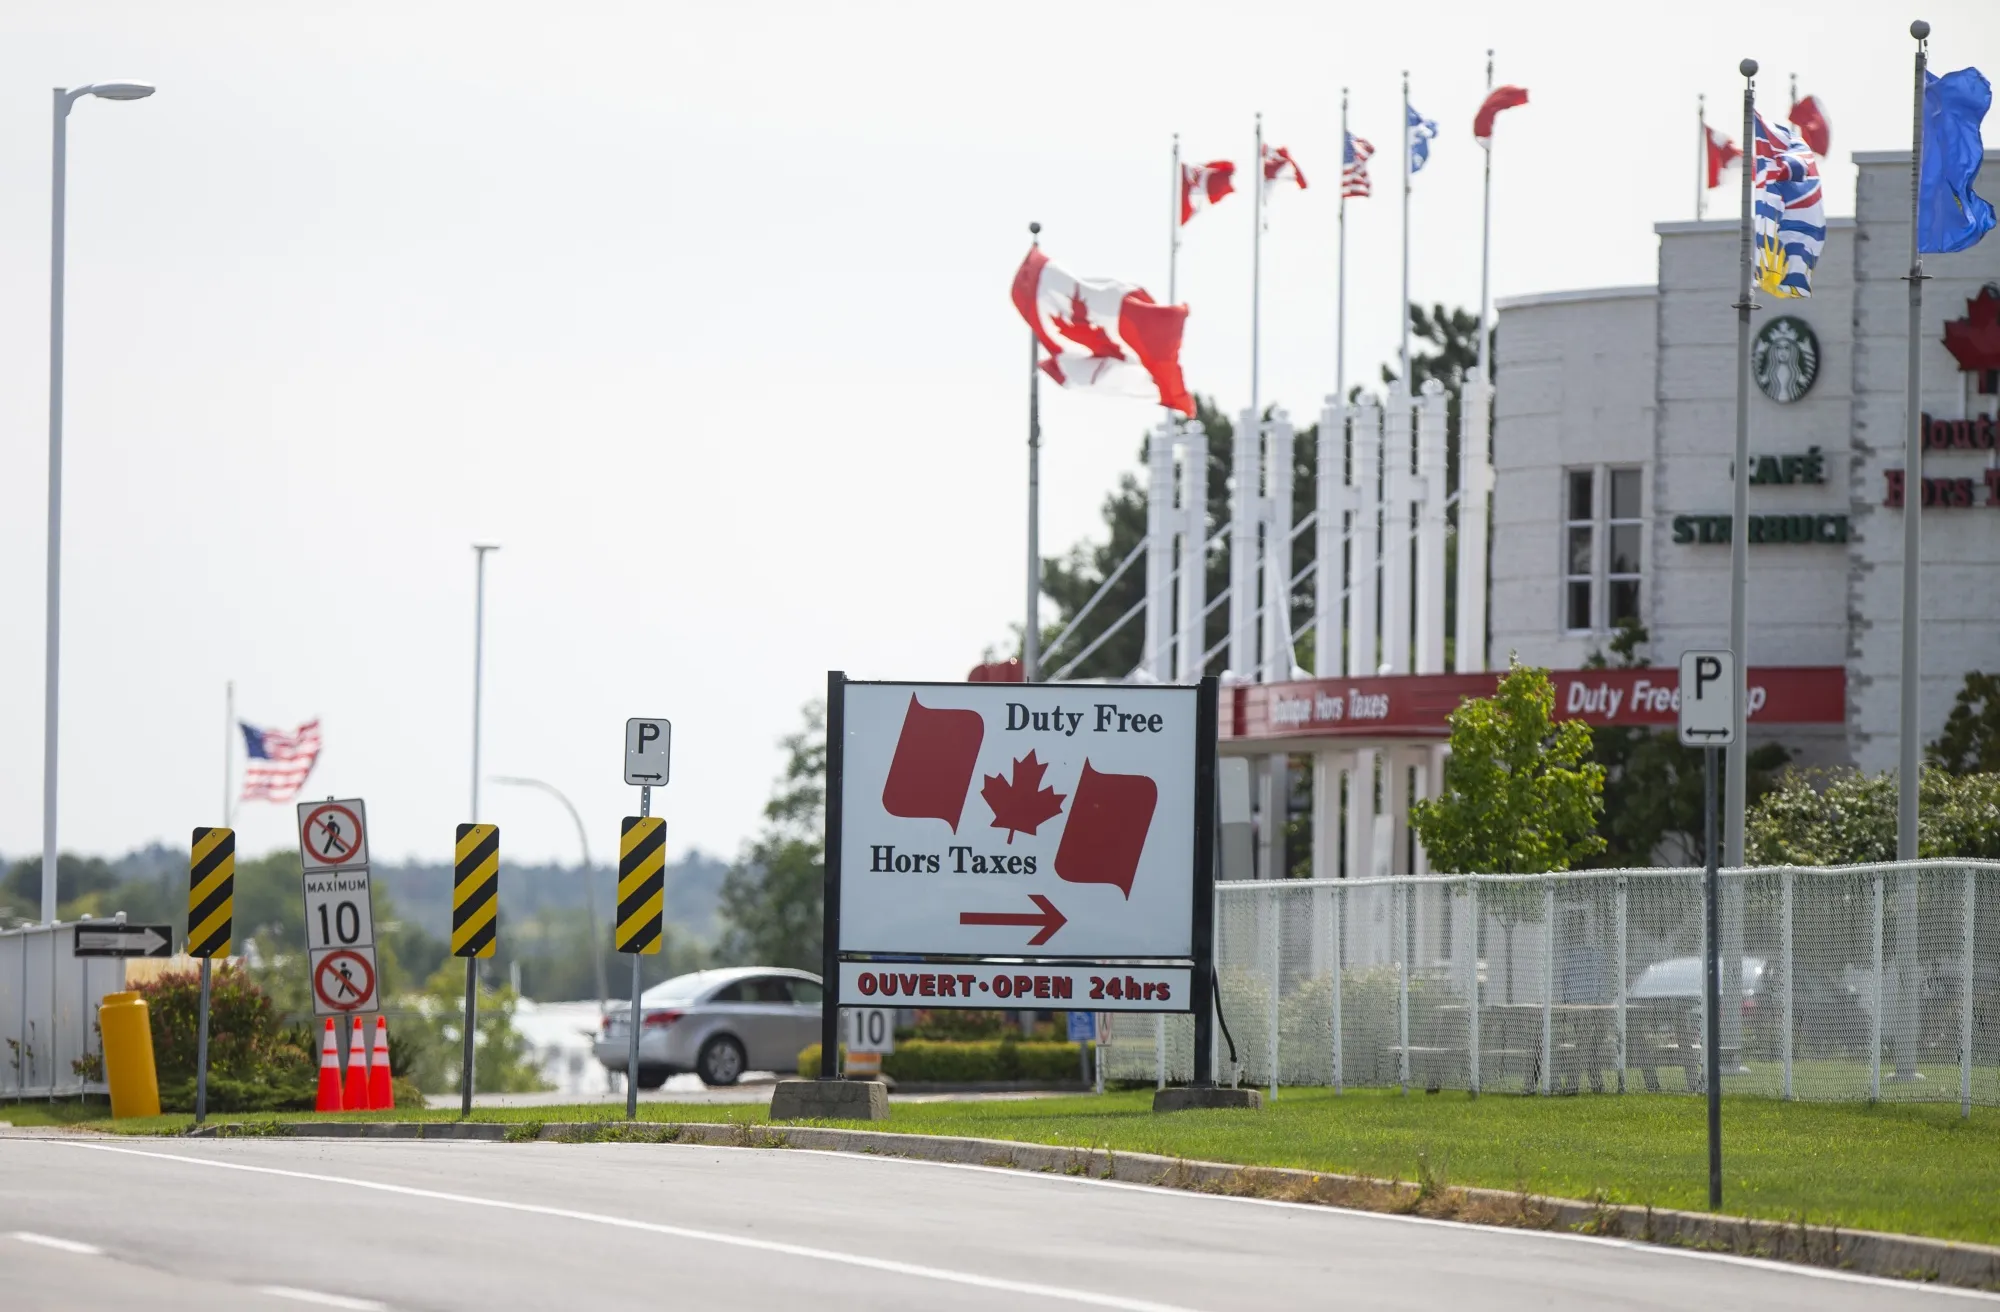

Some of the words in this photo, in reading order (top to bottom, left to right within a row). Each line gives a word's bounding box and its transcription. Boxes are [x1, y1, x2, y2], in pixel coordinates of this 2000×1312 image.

[1696, 656, 1722, 700] P
[1348, 688, 1388, 719] Taxes
[1567, 681, 1623, 719] Duty
[1005, 702, 1084, 737] Duty
[1093, 704, 1164, 733] Free
[638, 723, 660, 754] P
[870, 845, 940, 873] Hors
[948, 846, 1037, 875] Taxes
[307, 879, 367, 893] MAXIMUM
[317, 901, 360, 945] 10
[1089, 976, 1172, 1001] 24hrs
[856, 1010, 885, 1045] 10
